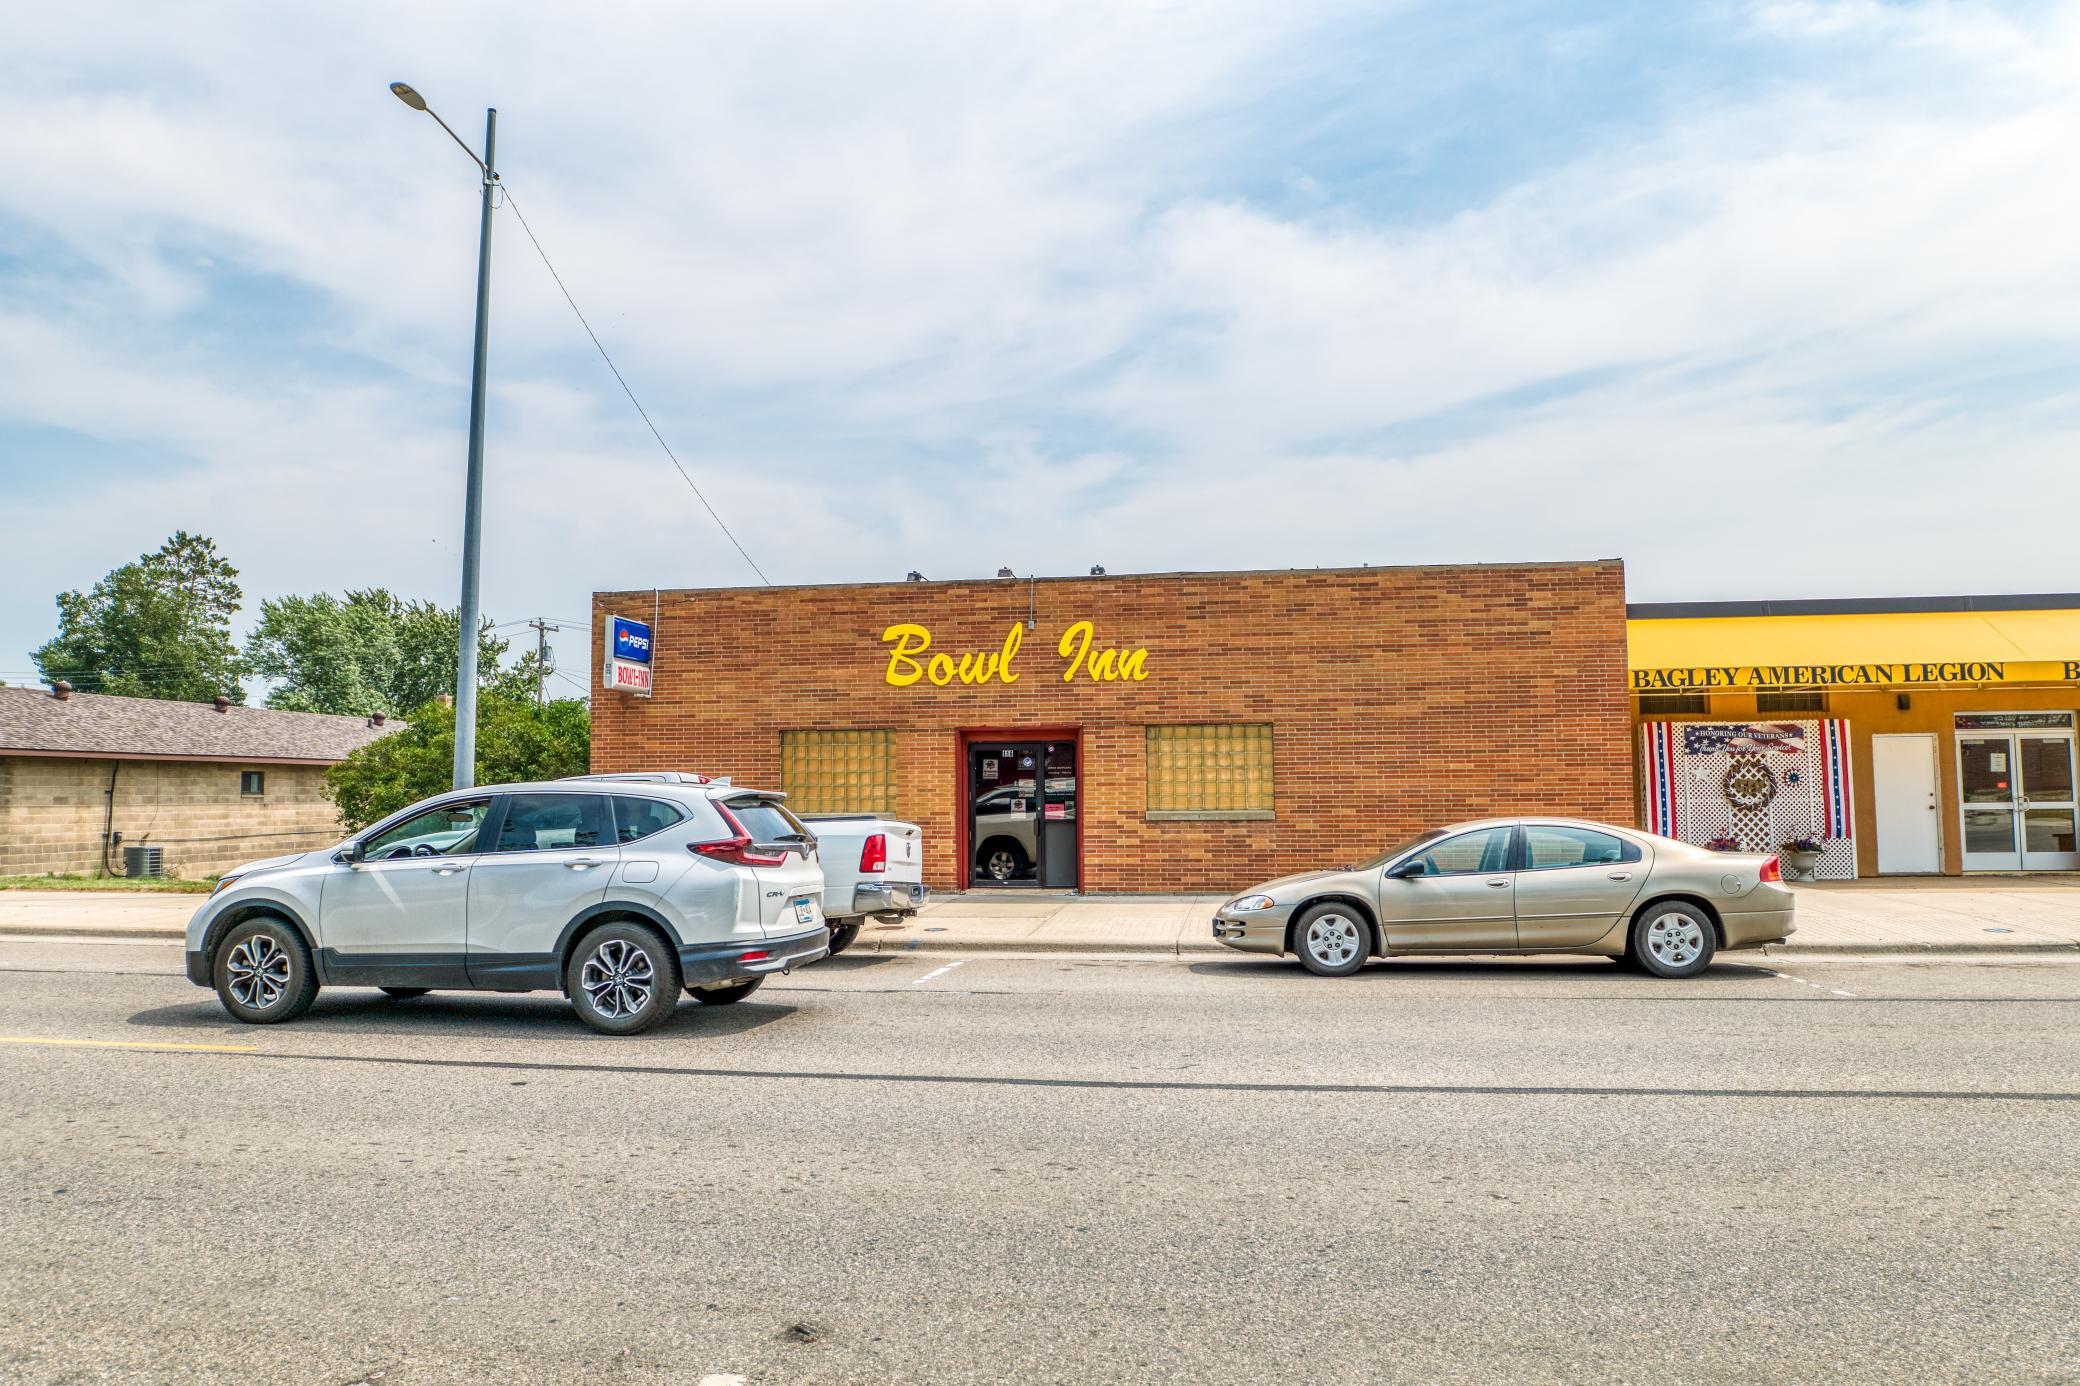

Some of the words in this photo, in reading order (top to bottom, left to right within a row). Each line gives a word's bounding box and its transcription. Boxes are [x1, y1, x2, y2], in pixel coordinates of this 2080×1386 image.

[628, 635, 649, 650] PEPSI
[882, 622, 1023, 687] Bowl
[1059, 621, 1150, 682] Inn
[618, 665, 649, 688] BOWL-INN
[1632, 667, 1740, 688] BAGLEY
[1747, 664, 1893, 686] AMERICAN
[1903, 662, 2005, 682] LEGION
[1700, 730, 1737, 738] HONORING
[1699, 743, 1721, 753] Thank
[1721, 744, 1735, 753] You
[1735, 744, 1745, 754] for
[1745, 744, 1764, 754] Your
